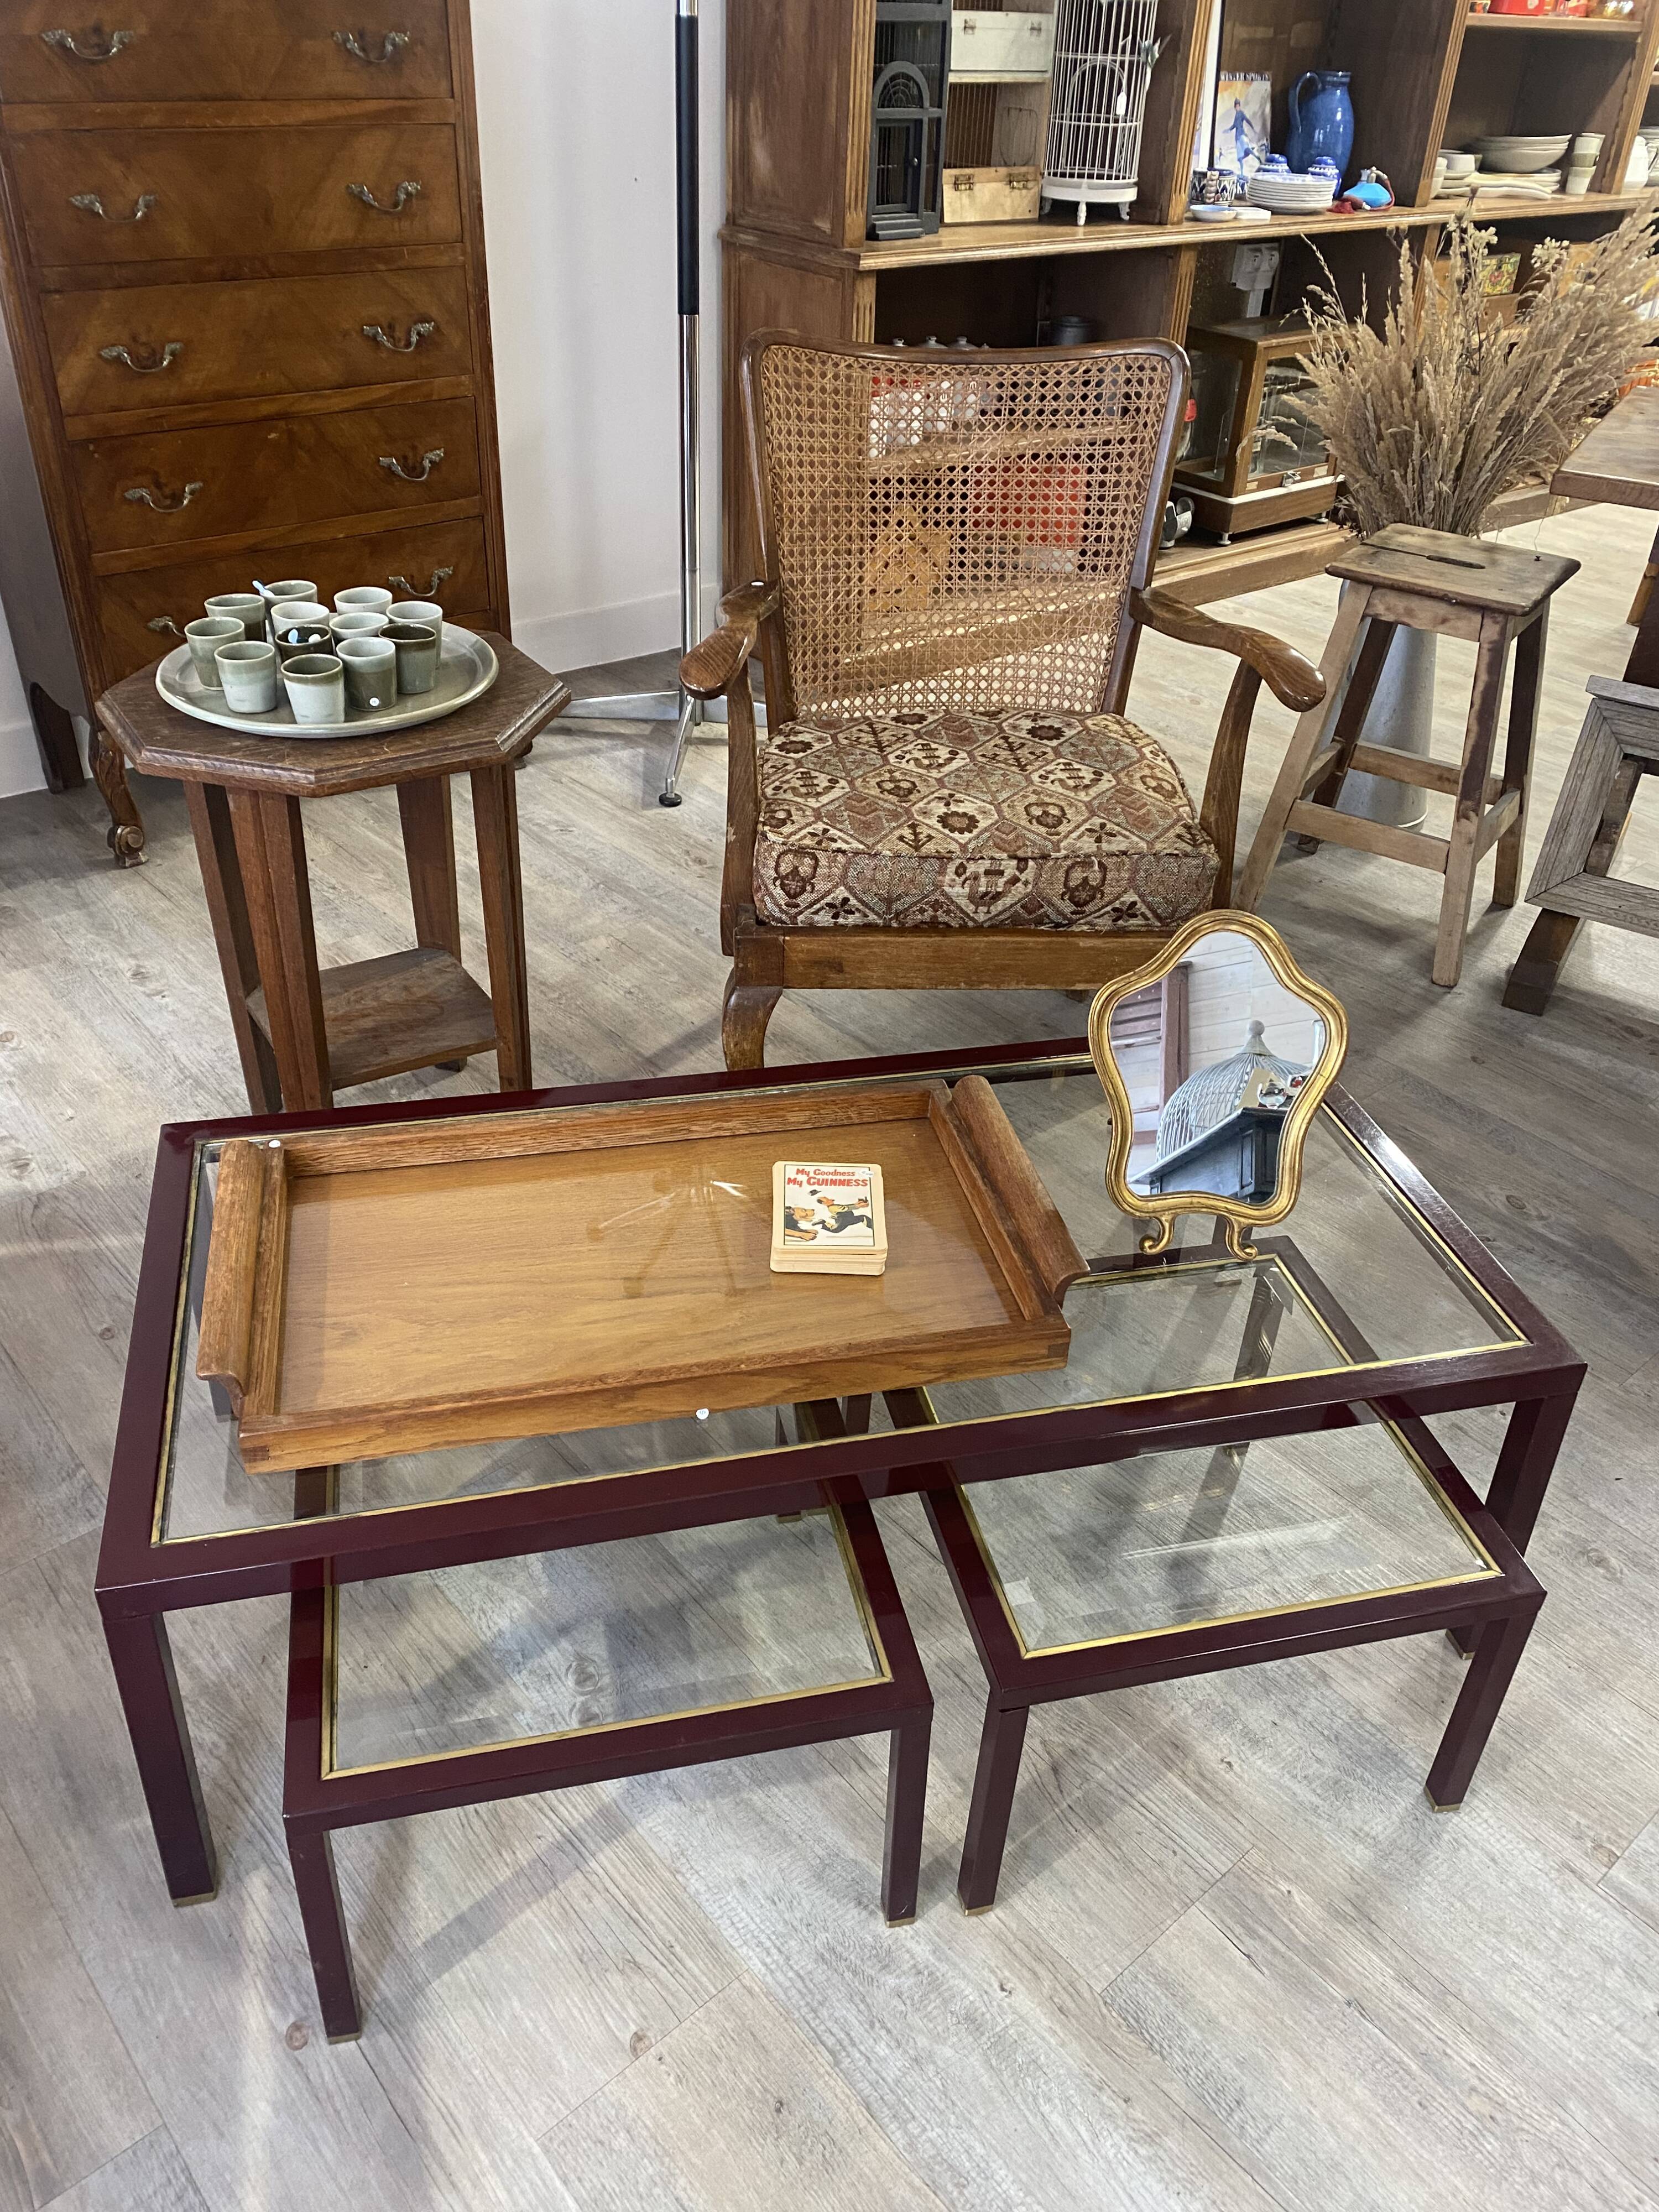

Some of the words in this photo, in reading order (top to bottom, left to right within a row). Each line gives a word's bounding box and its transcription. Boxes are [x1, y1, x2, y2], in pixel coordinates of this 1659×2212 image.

[796, 1168, 810, 1177] My
[787, 1177, 803, 1187] My
[806, 1177, 868, 1187] GUINNESS
